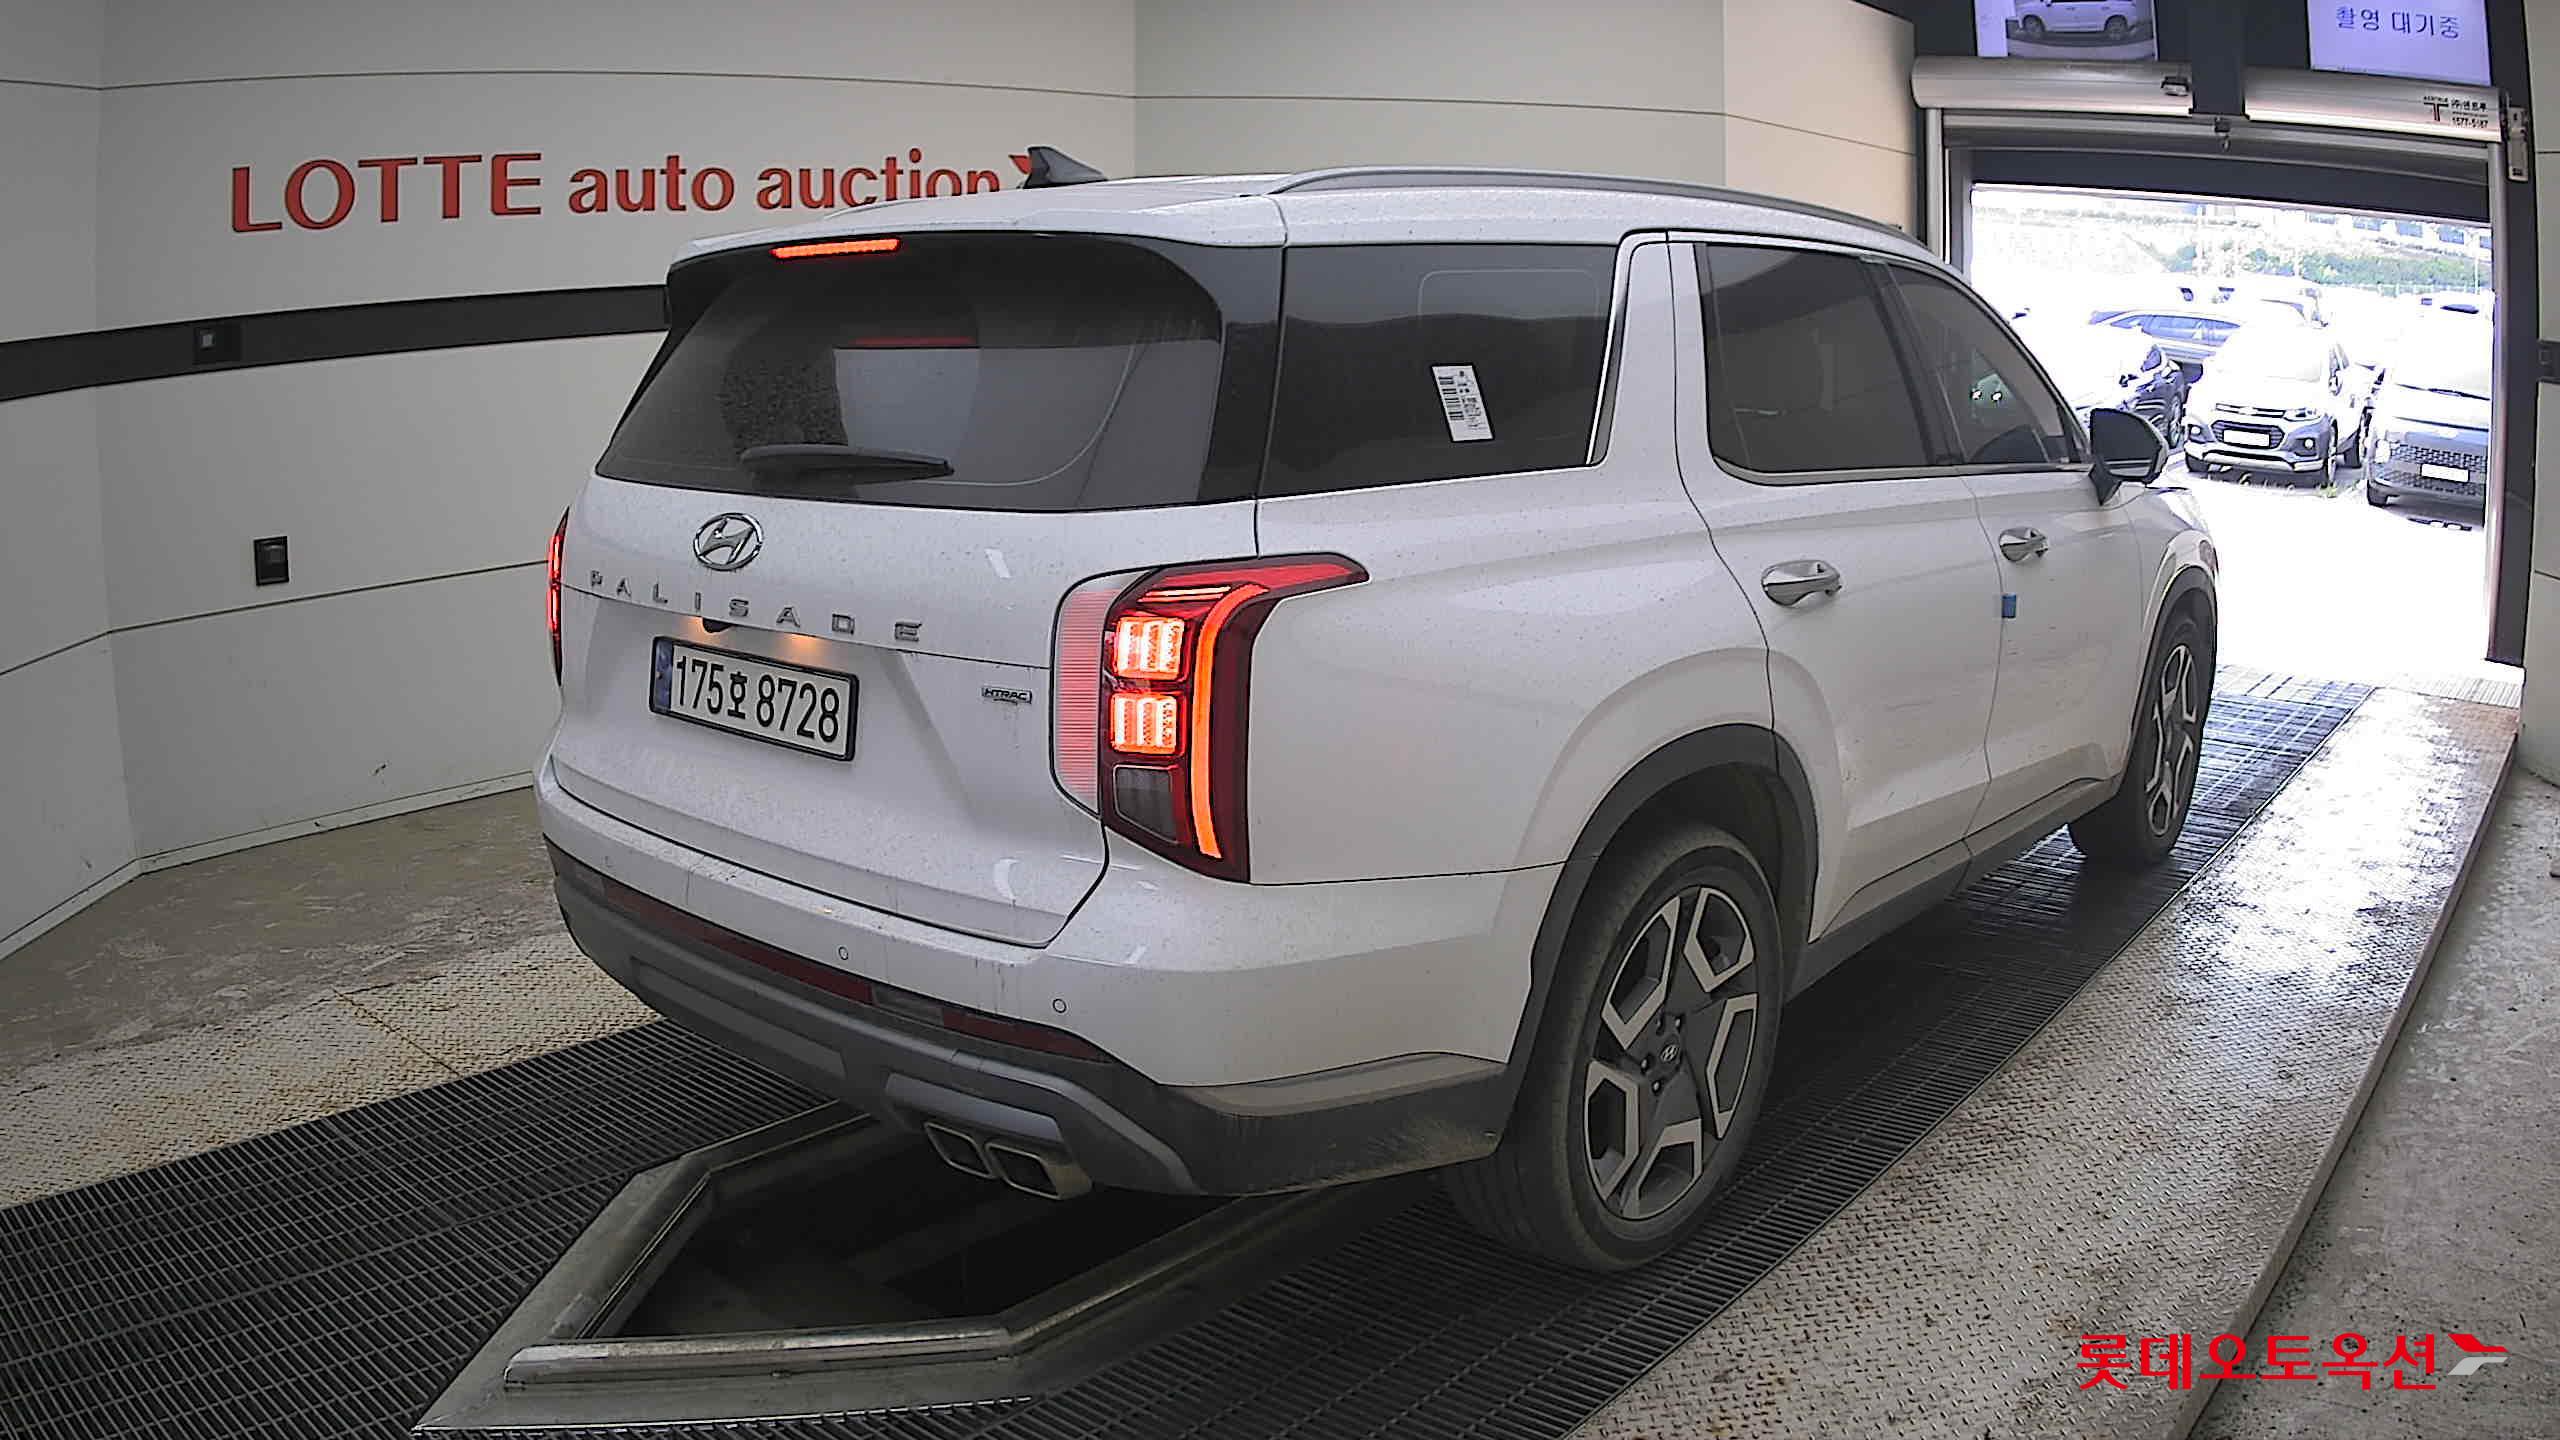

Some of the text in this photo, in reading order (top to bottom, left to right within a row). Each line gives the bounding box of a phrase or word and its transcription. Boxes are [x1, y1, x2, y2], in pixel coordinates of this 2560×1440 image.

[2336, 6, 2460, 39] 촬영 대기중
[231, 147, 1001, 233] LOTTE auto auction
[589, 569, 923, 643] PALISADE
[675, 655, 841, 743] 175호 8728
[984, 687, 1028, 701] HTRAC
